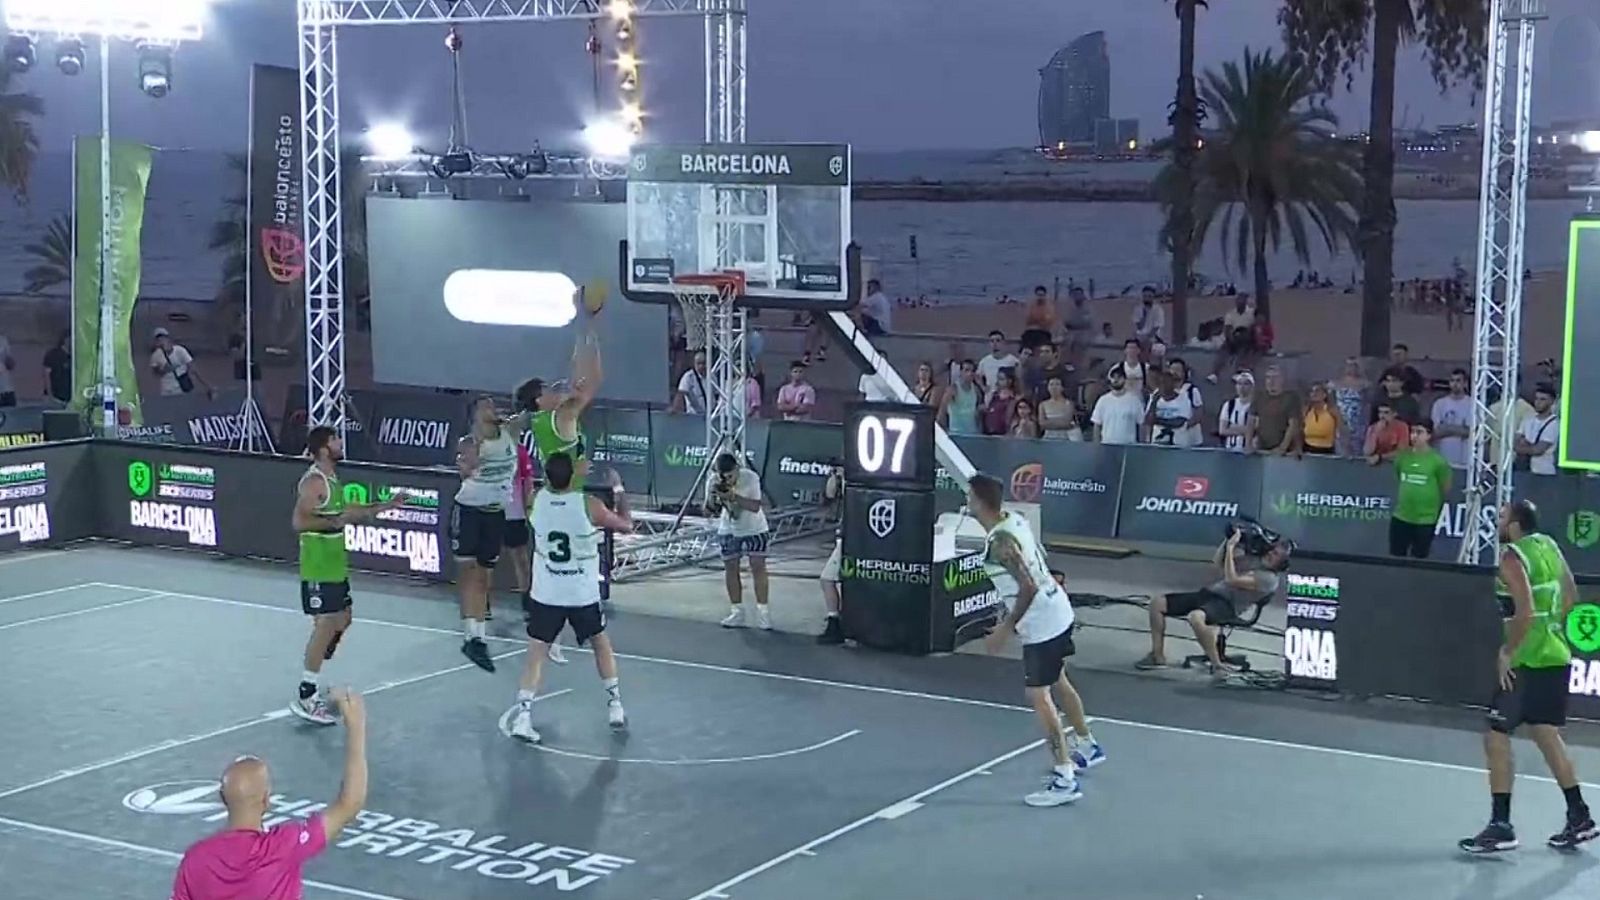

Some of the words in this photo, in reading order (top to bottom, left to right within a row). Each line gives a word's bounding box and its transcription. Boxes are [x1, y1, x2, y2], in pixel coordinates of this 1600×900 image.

[681, 154, 791, 174] BARCELONA
[378, 417, 450, 448] MADISON
[857, 415, 915, 473] 07
[1296, 493, 1391, 508] HERBALIFE
[1296, 504, 1390, 521] NUTRITION
[130, 500, 215, 533] BARCELONA
[345, 524, 439, 560] BARCELONA
[548, 530, 571, 562] 3
[856, 558, 930, 573] HERBALIFE
[856, 569, 930, 584] NUTRITION
